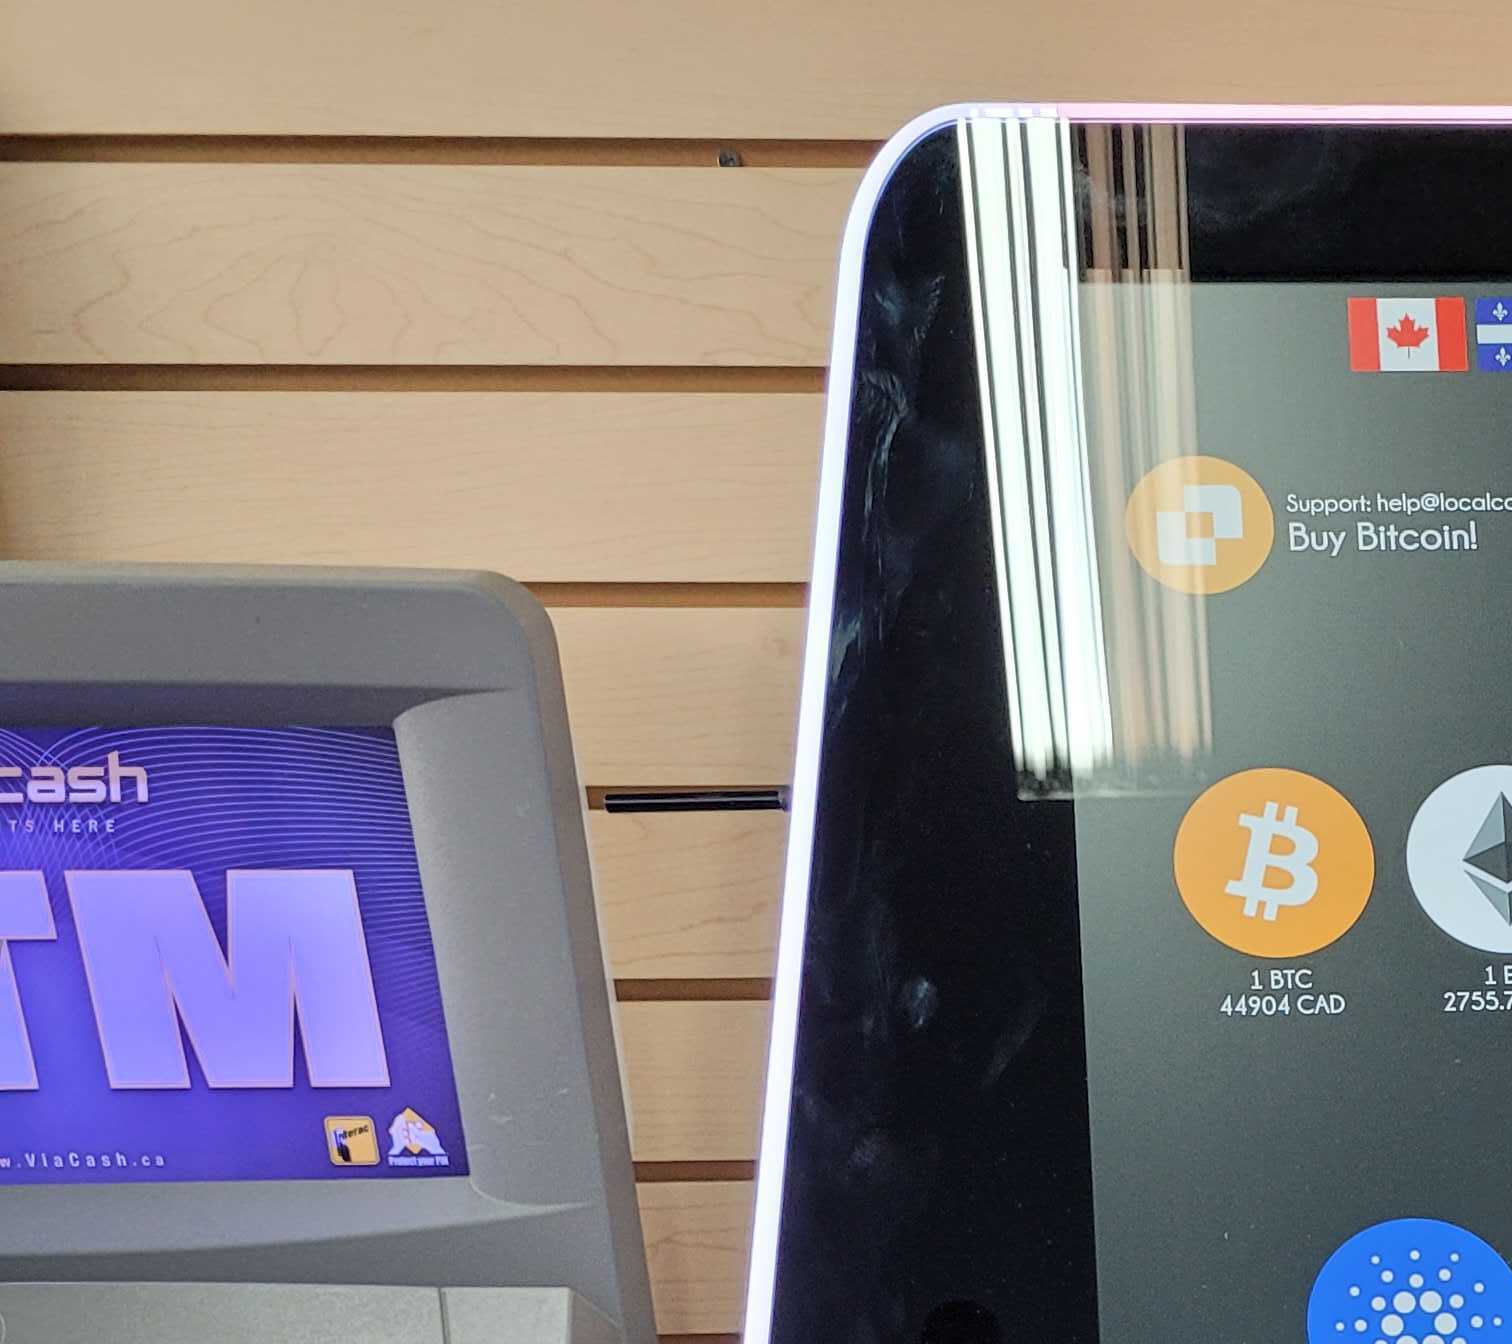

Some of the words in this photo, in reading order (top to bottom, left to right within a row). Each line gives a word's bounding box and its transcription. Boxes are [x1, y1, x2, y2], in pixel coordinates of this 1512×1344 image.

[1286, 493, 1372, 516] Support:
[1289, 523, 1346, 556] Buy
[1357, 520, 1478, 552] Bitcoin!
[54, 820, 115, 832] HERE
[1251, 970, 1262, 990] 1
[1269, 969, 1313, 990] BTC
[1485, 965, 1495, 986] 1
[1220, 994, 1291, 1017] 44904
[1297, 993, 1346, 1016] CAD
